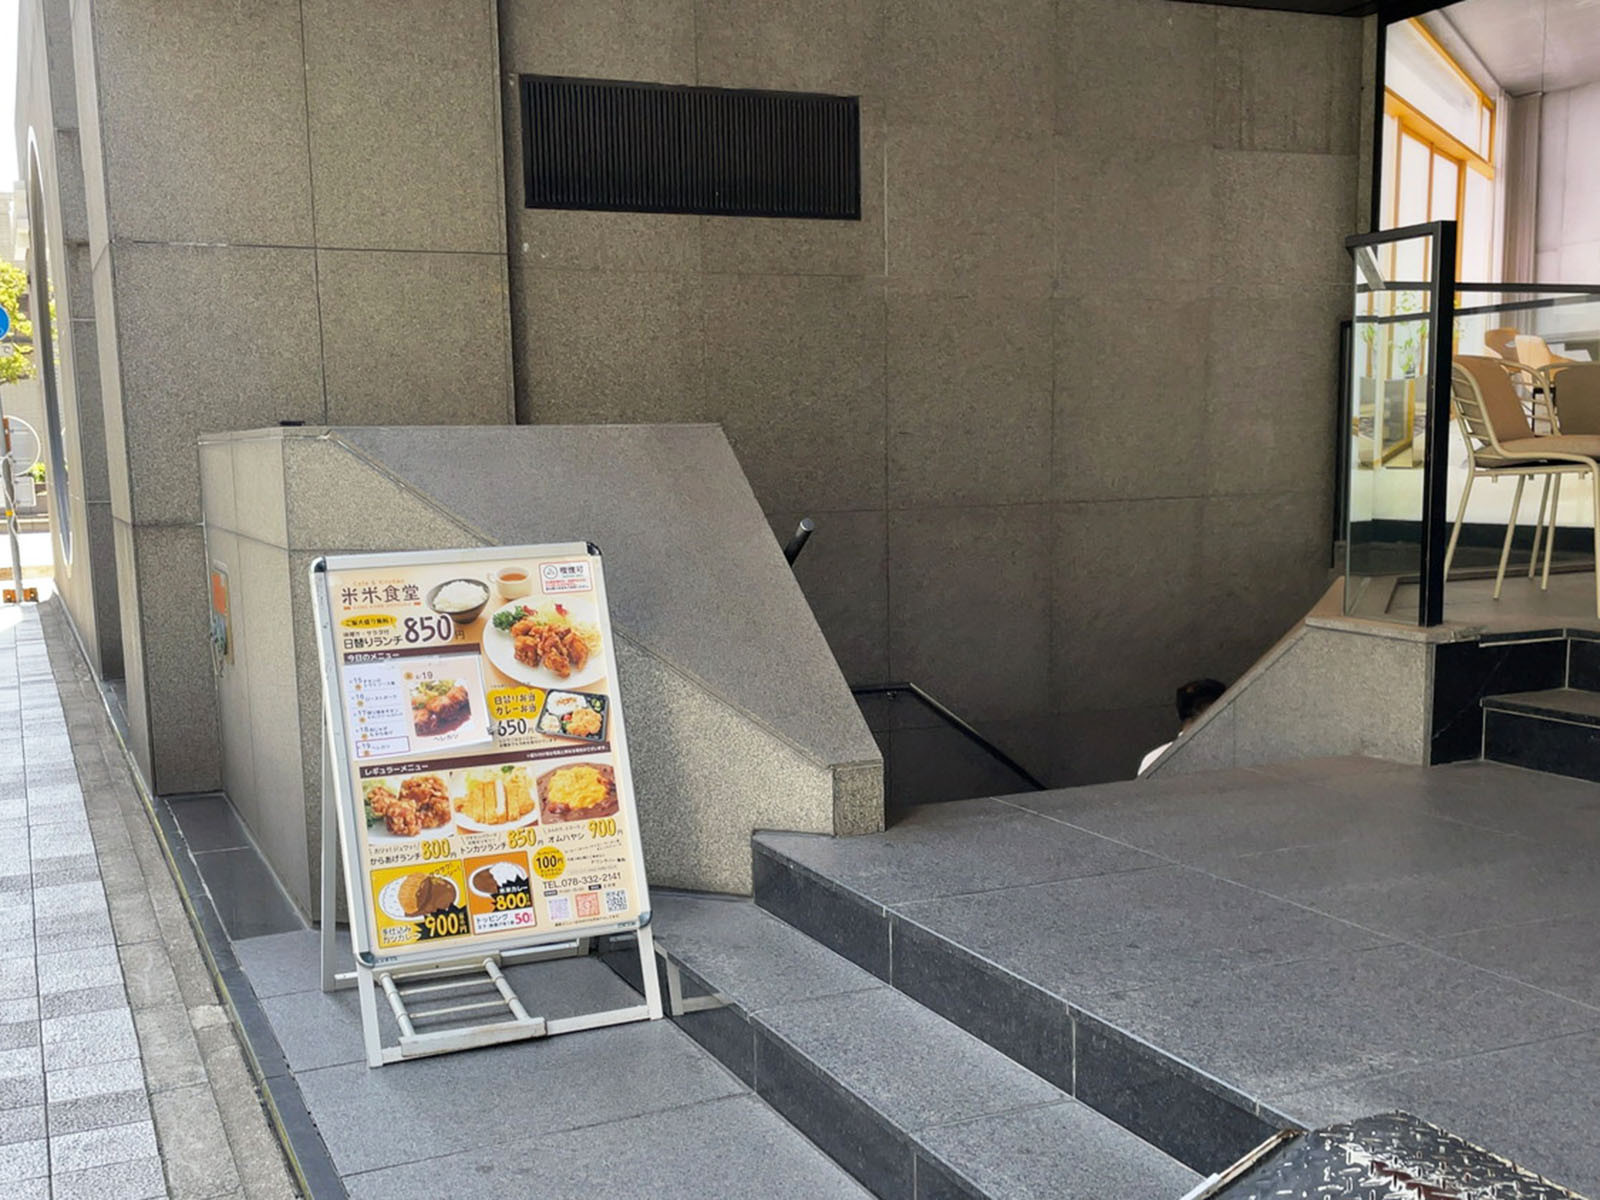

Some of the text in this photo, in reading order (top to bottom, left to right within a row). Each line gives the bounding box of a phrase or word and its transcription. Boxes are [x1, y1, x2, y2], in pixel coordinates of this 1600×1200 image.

[341, 584, 421, 605] 米米食堂
[343, 635, 403, 650] 日替りランチ
[347, 652, 400, 662] 今日のメニュー
[364, 764, 429, 776] レギュラーメニュー
[370, 853, 420, 866] からあげランチ
